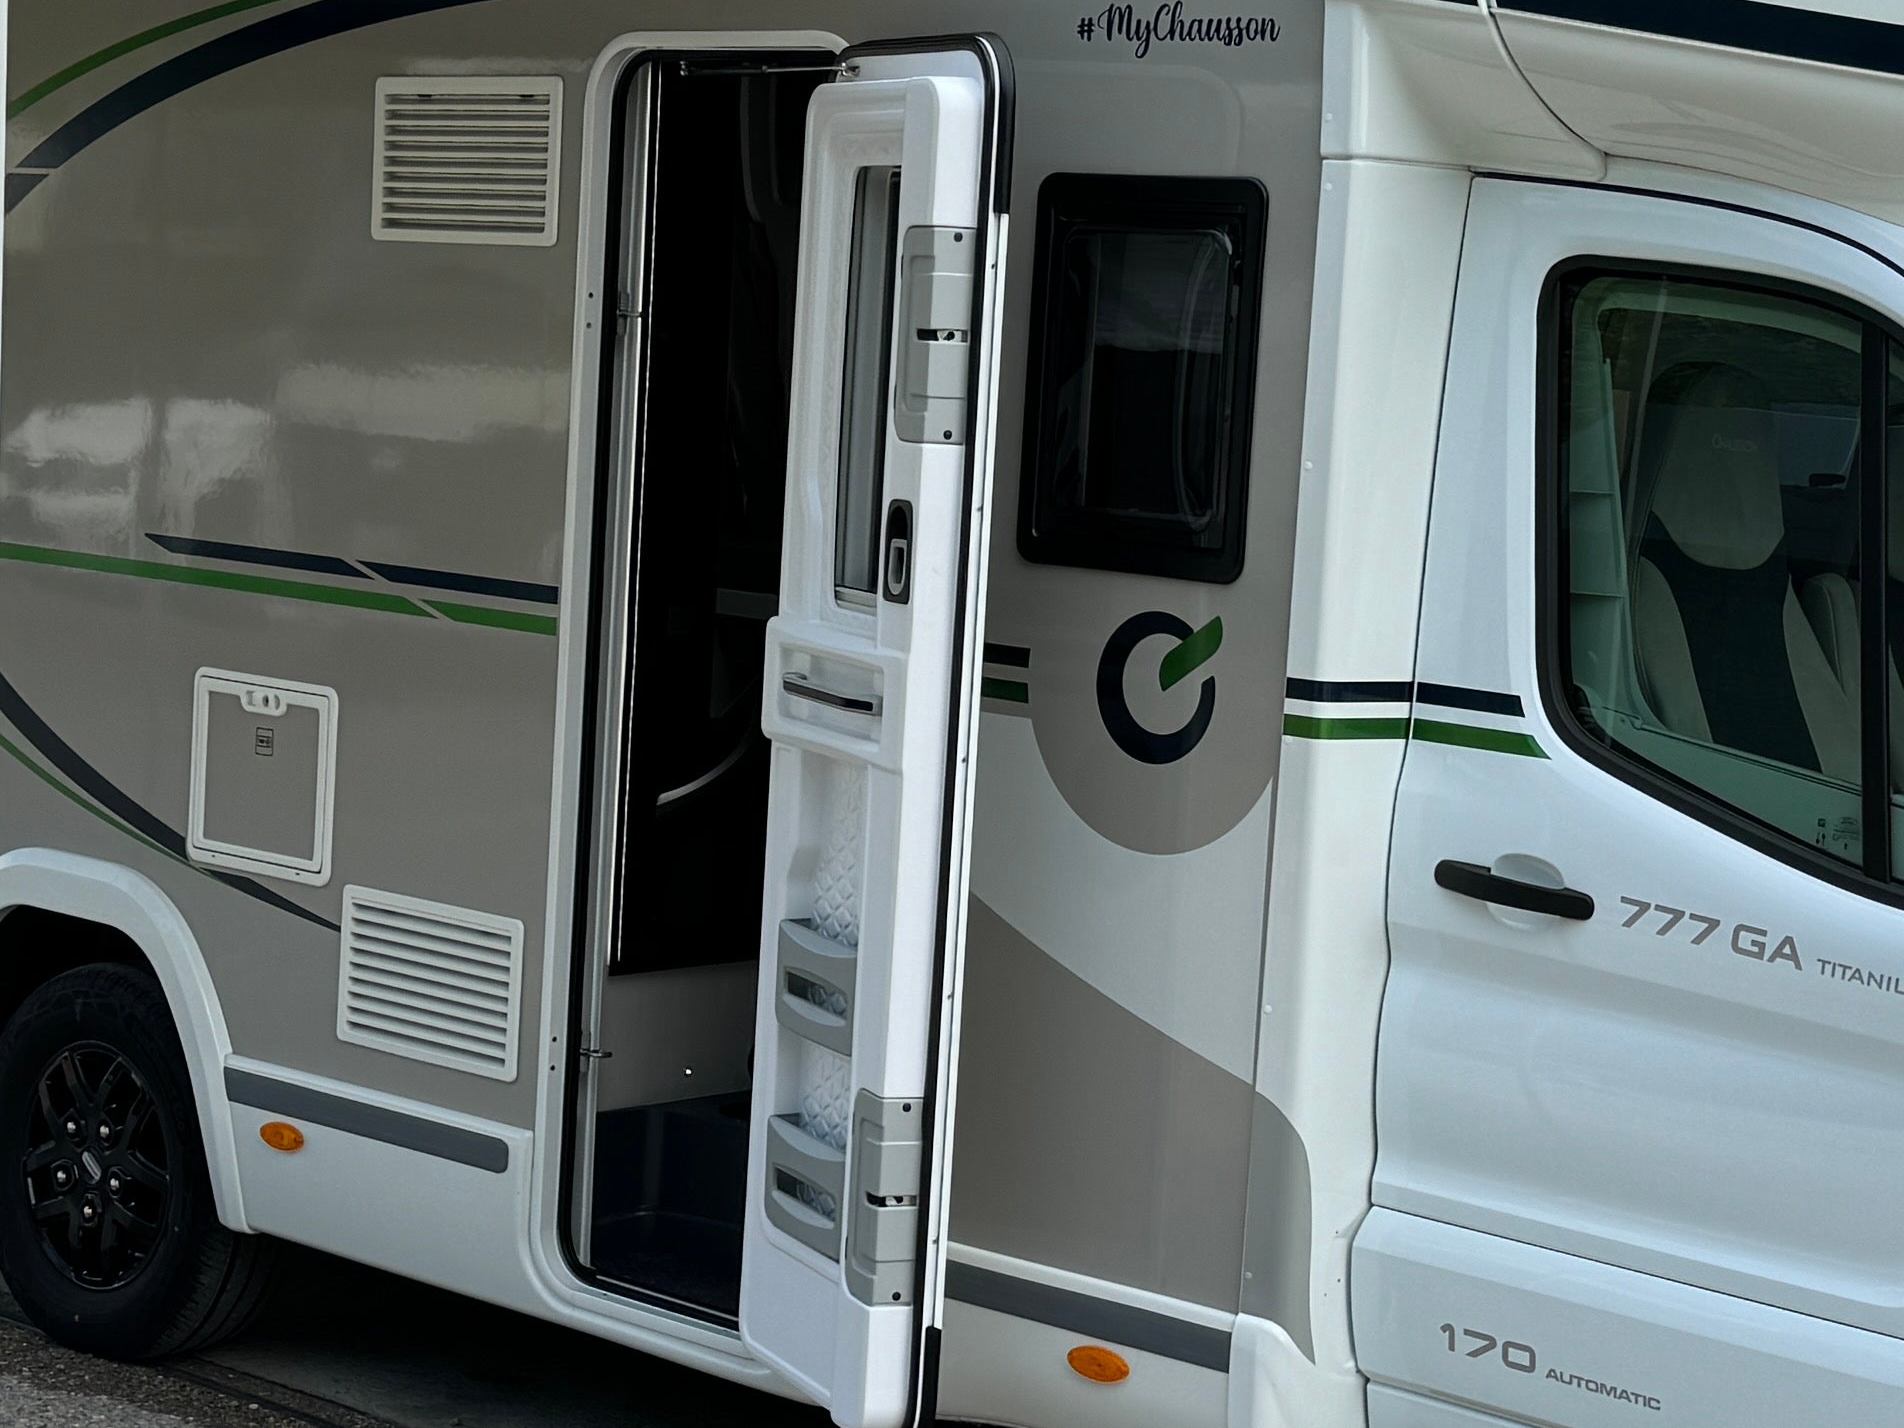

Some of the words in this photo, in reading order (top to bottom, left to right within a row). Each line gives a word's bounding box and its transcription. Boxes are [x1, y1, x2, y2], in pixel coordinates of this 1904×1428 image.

[1077, 0, 1280, 59] #MyChausson
[1619, 896, 1721, 945] 777
[1730, 923, 1803, 972] GA
[1439, 1322, 1536, 1375] 170
[1546, 1367, 1662, 1411] AUTOMATIC
